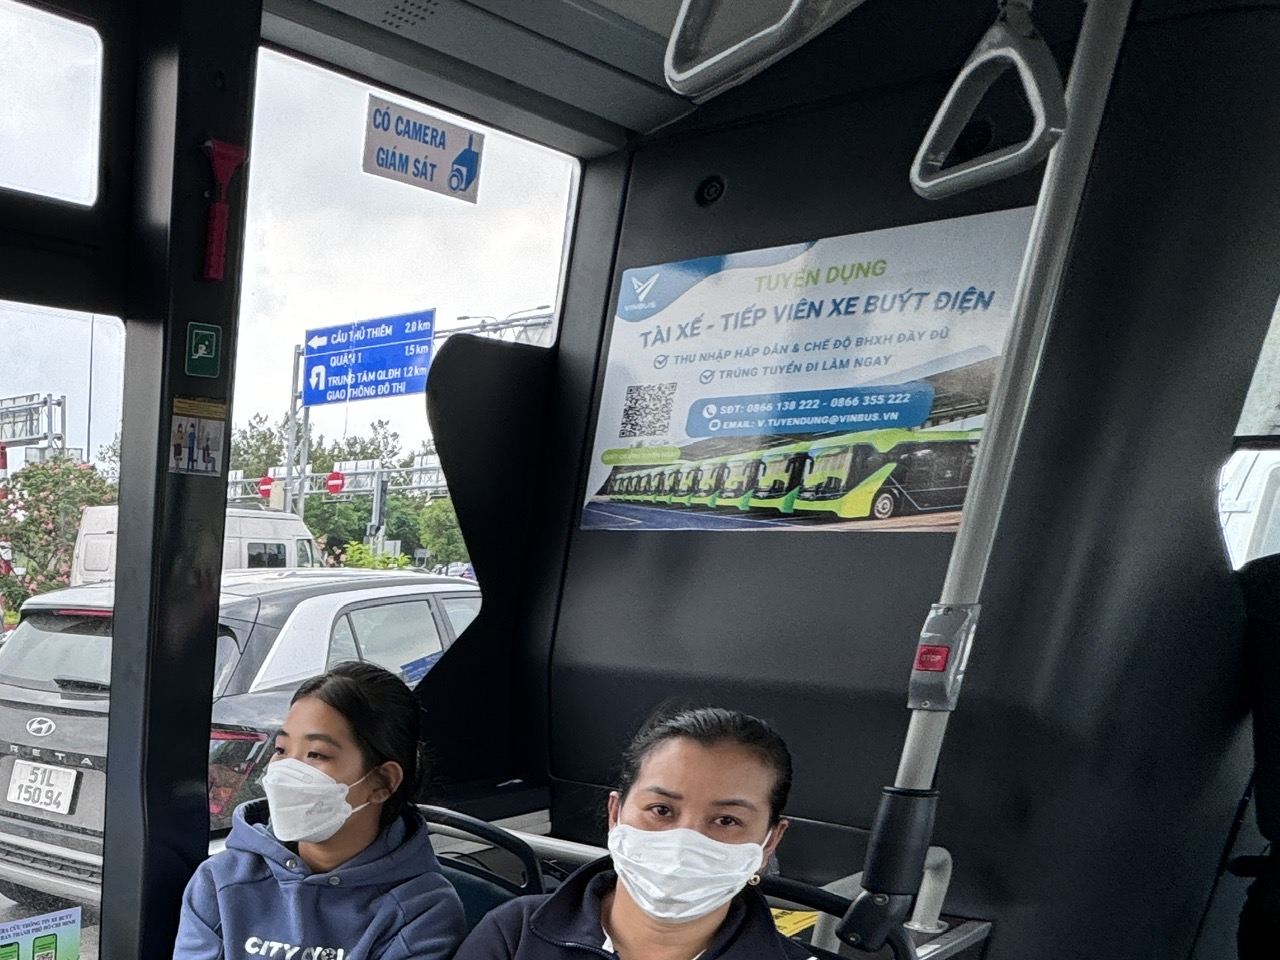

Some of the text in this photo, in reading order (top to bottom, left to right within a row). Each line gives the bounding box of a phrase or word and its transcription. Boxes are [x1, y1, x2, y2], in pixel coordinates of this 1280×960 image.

[373, 106, 446, 151] CÓ CAMERA
[376, 145, 437, 182] GIÁM SÁT
[755, 259, 888, 293] TUYỂN DỤNG
[639, 325, 672, 349] TÀI
[675, 312, 705, 341] XẾ
[720, 303, 767, 332] TIẾP
[773, 297, 824, 323] VIÊN
[827, 296, 860, 318] XE
[862, 287, 931, 314] BUÝT
[933, 285, 996, 316] ĐIỆN
[366, 323, 393, 339] THIÊM
[417, 319, 431, 331] km
[415, 343, 429, 355] km
[673, 353, 697, 365] THU
[698, 349, 732, 364] NHẬP
[733, 345, 760, 359] HẤP
[791, 343, 800, 353] &
[804, 336, 831, 352] CHẾ
[833, 335, 852, 350] ĐỘ
[855, 334, 894, 348] BHXH
[897, 329, 926, 343] ĐẦY
[327, 371, 356, 388] TRUNG
[357, 369, 376, 384] TÂM
[414, 365, 427, 377] km
[762, 360, 802, 376] TUYỂN
[805, 362, 819, 372] ĐI
[821, 356, 850, 371] LÀM
[854, 355, 893, 368] NGAY
[326, 387, 346, 401] GIAO
[348, 383, 376, 399] THÔNG
[776, 400, 796, 411] 138
[798, 399, 820, 410] 222
[830, 396, 859, 408] 0866
[862, 395, 886, 406] 355
[887, 393, 911, 404] 222
[28, 766, 55, 788] 51L
[17, 783, 63, 809] 150.94
[244, 936, 300, 960] CITY
